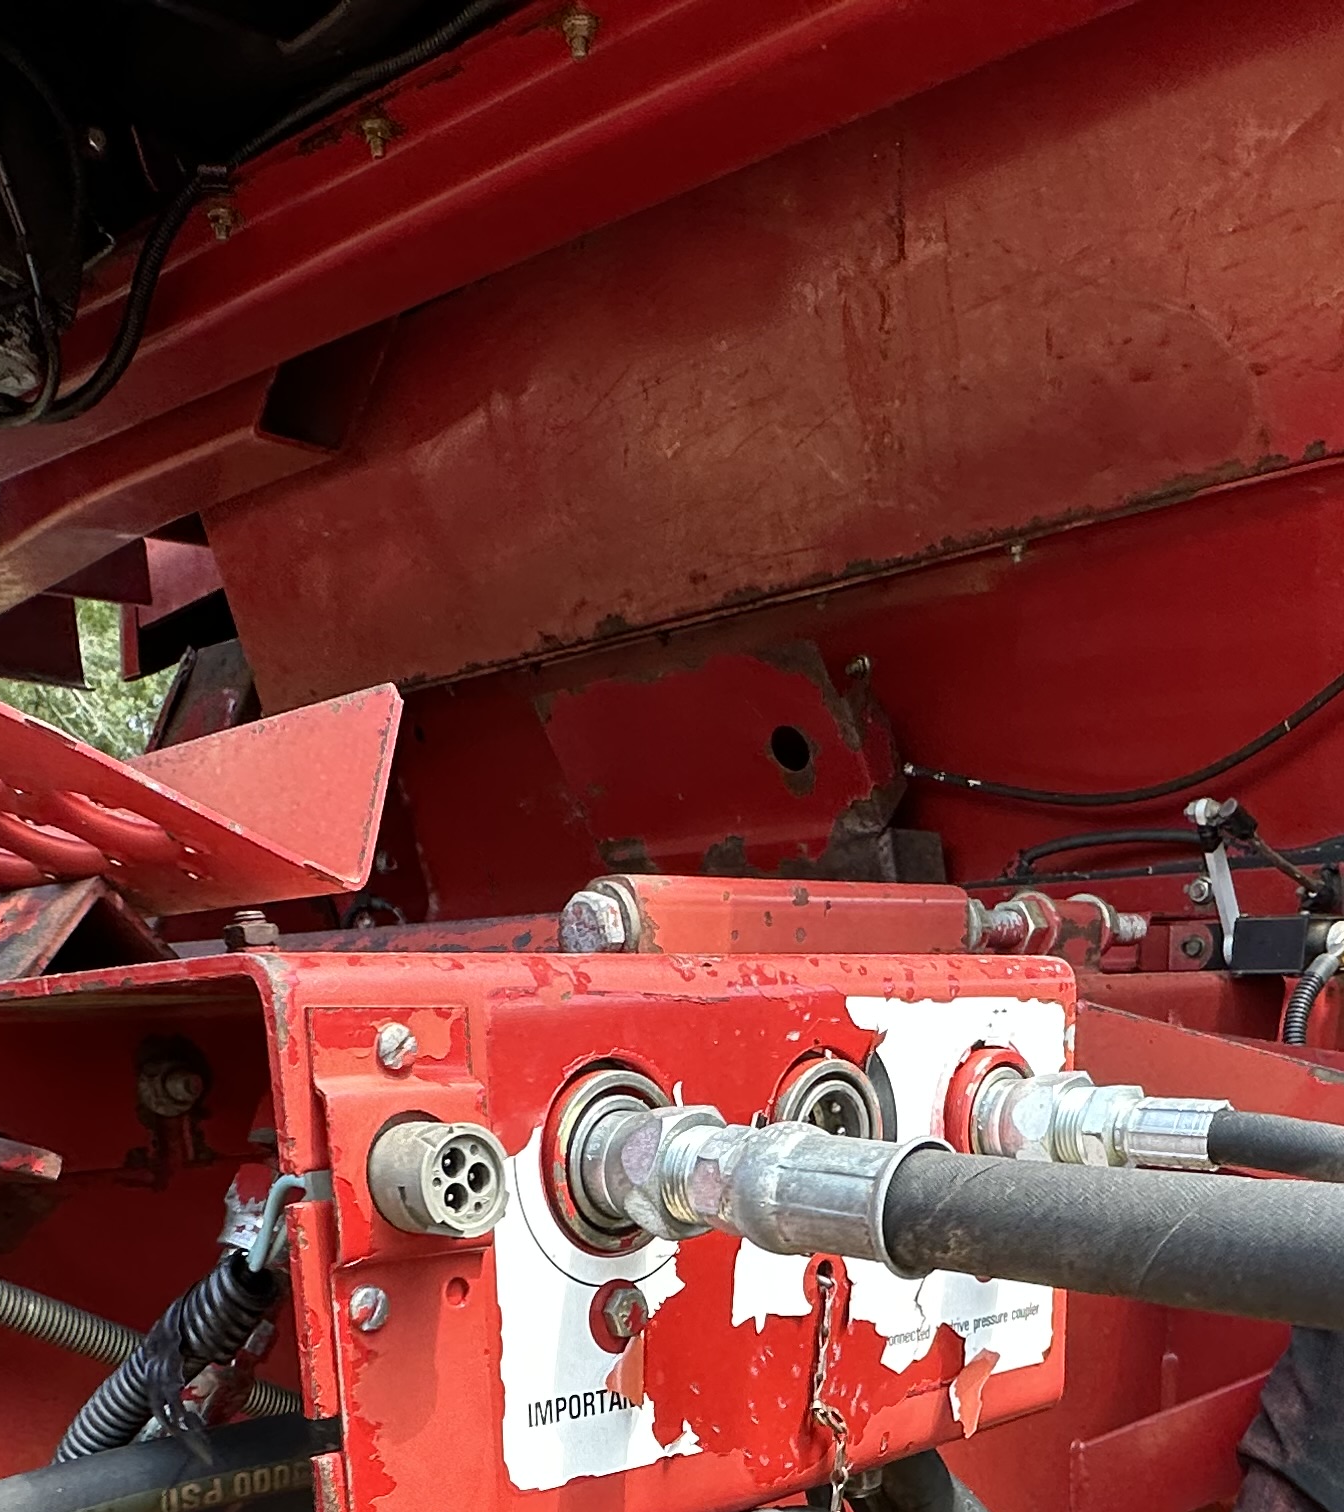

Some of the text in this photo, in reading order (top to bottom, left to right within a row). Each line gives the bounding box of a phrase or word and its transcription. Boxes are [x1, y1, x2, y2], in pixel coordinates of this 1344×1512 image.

[888, 1325, 931, 1346] onnected
[973, 1311, 1008, 1334] pressure
[1011, 1302, 1039, 1321] coupler
